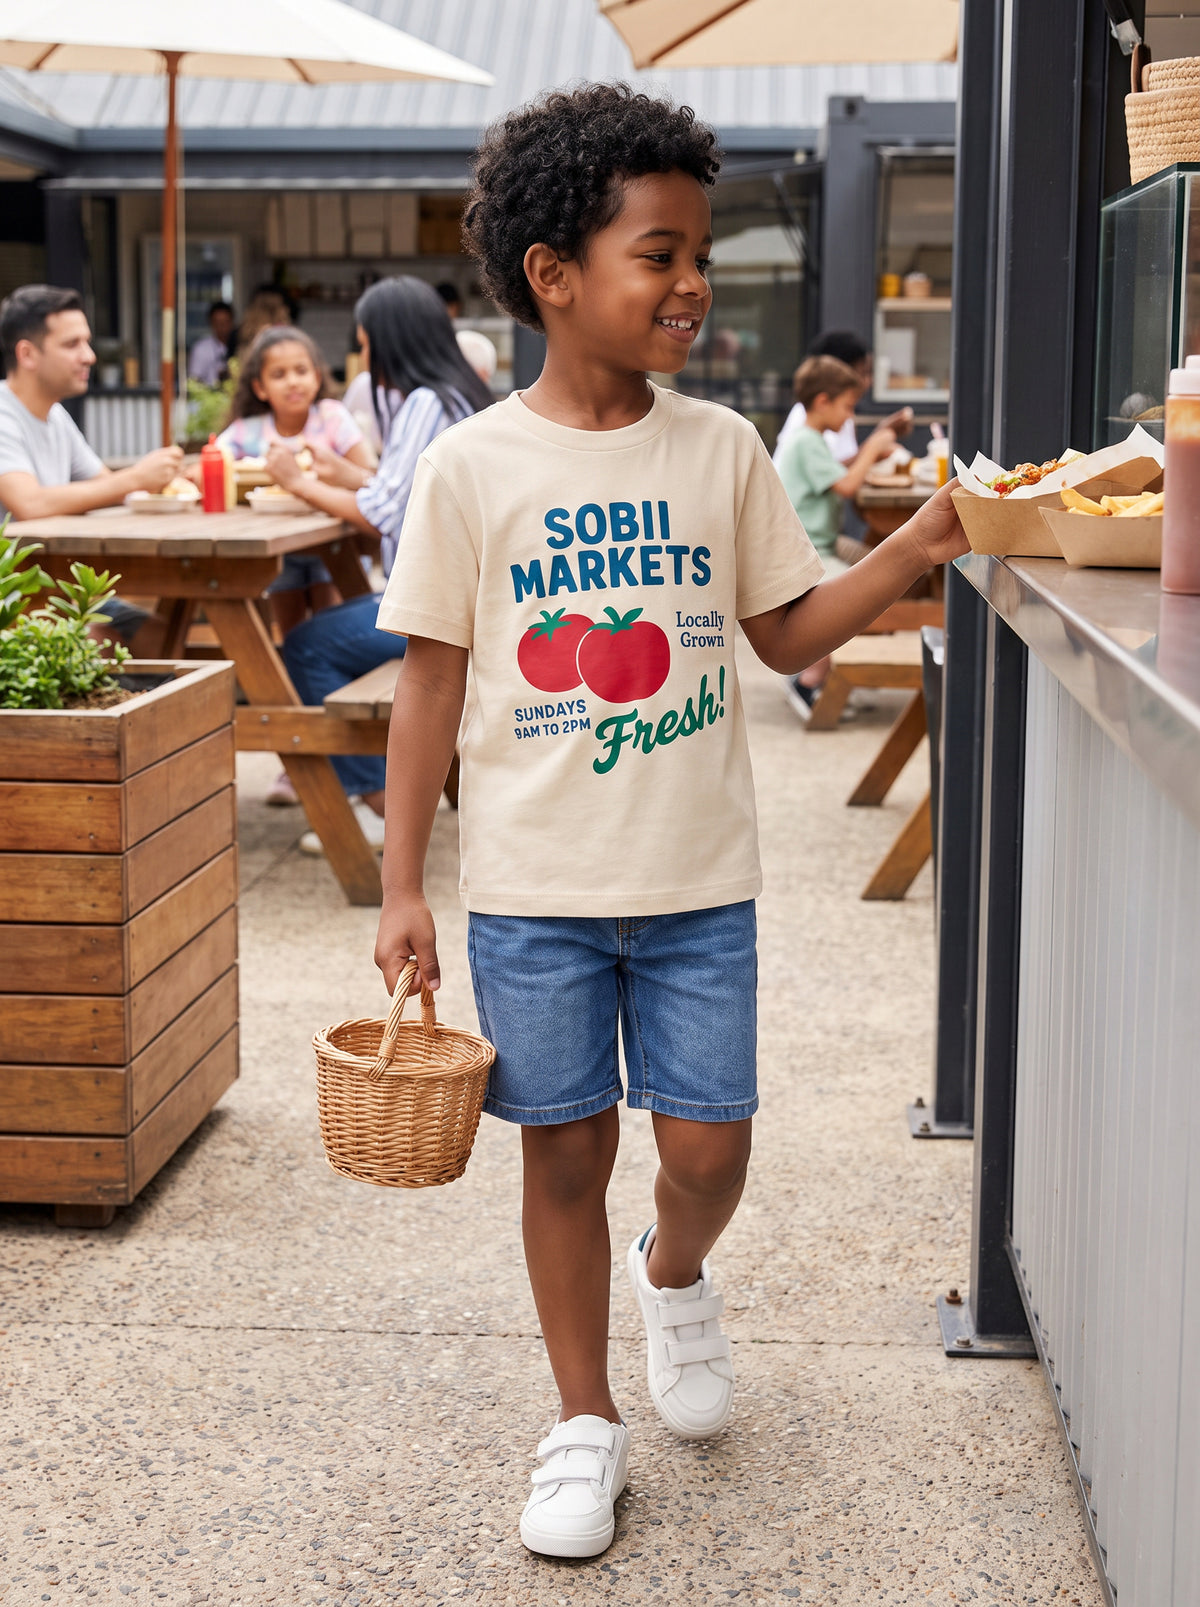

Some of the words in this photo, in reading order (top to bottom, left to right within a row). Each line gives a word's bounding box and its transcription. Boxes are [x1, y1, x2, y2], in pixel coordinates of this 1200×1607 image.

[543, 500, 671, 550] SOBII
[509, 544, 712, 604] MARKETS
[675, 610, 725, 632] Locally
[679, 631, 725, 648] Grown
[514, 699, 587, 723] SUNDAYS
[592, 664, 726, 775] Fresh!
[514, 725, 541, 740] 9AM
[542, 722, 560, 736] TO
[562, 717, 592, 733] 2PM
